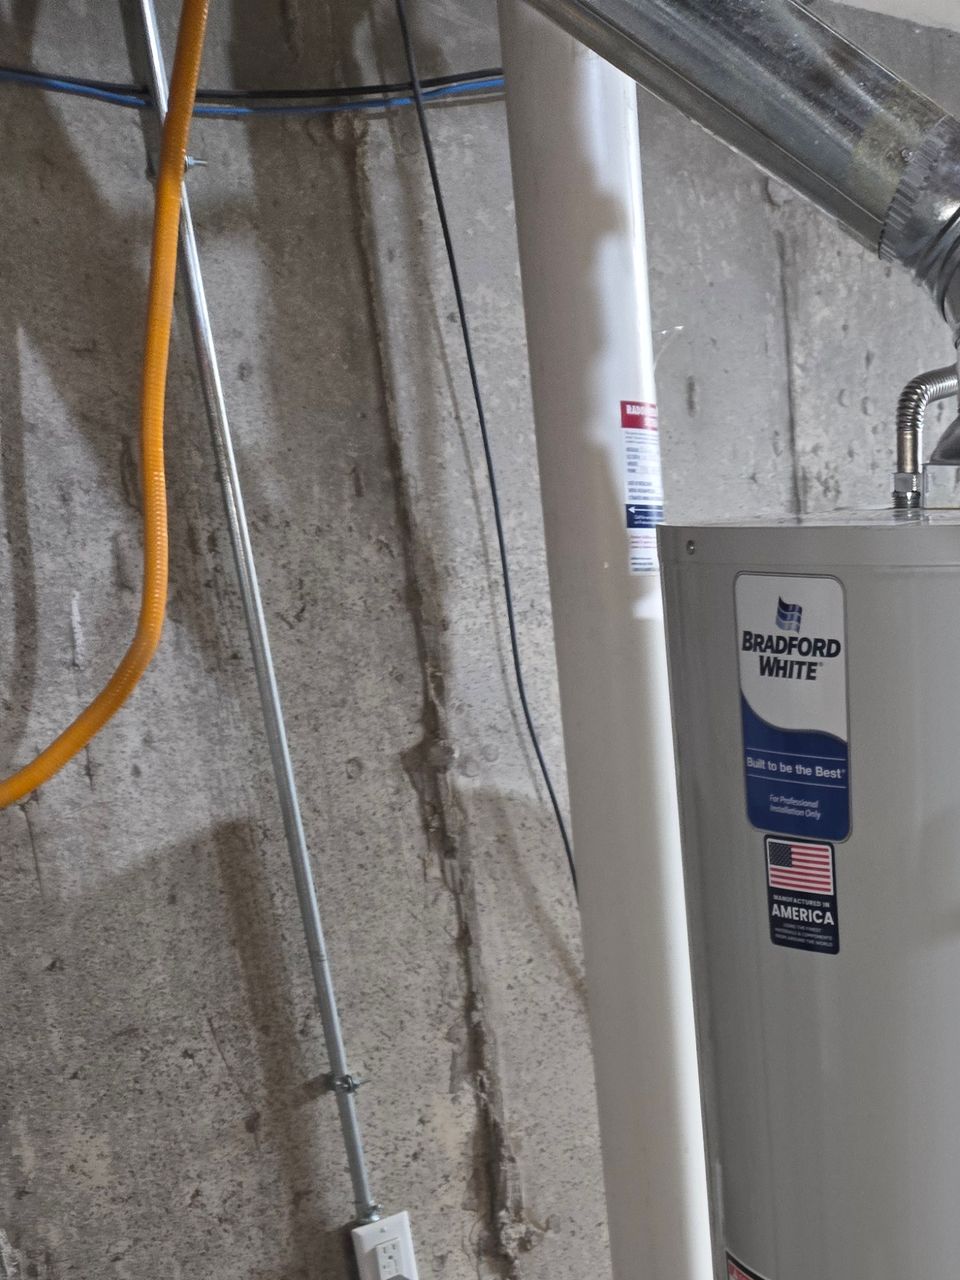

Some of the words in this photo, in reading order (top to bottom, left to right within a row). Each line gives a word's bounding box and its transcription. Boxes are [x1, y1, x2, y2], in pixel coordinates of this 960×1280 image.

[742, 630, 841, 658] BRADFORD
[759, 655, 818, 680] WHITE
[747, 757, 766, 770] Built
[768, 760, 777, 771] to
[780, 762, 792, 773] be
[796, 765, 812, 776] the
[815, 766, 842, 779] Best
[805, 809, 821, 821] Only
[772, 903, 835, 925] AMERICA
